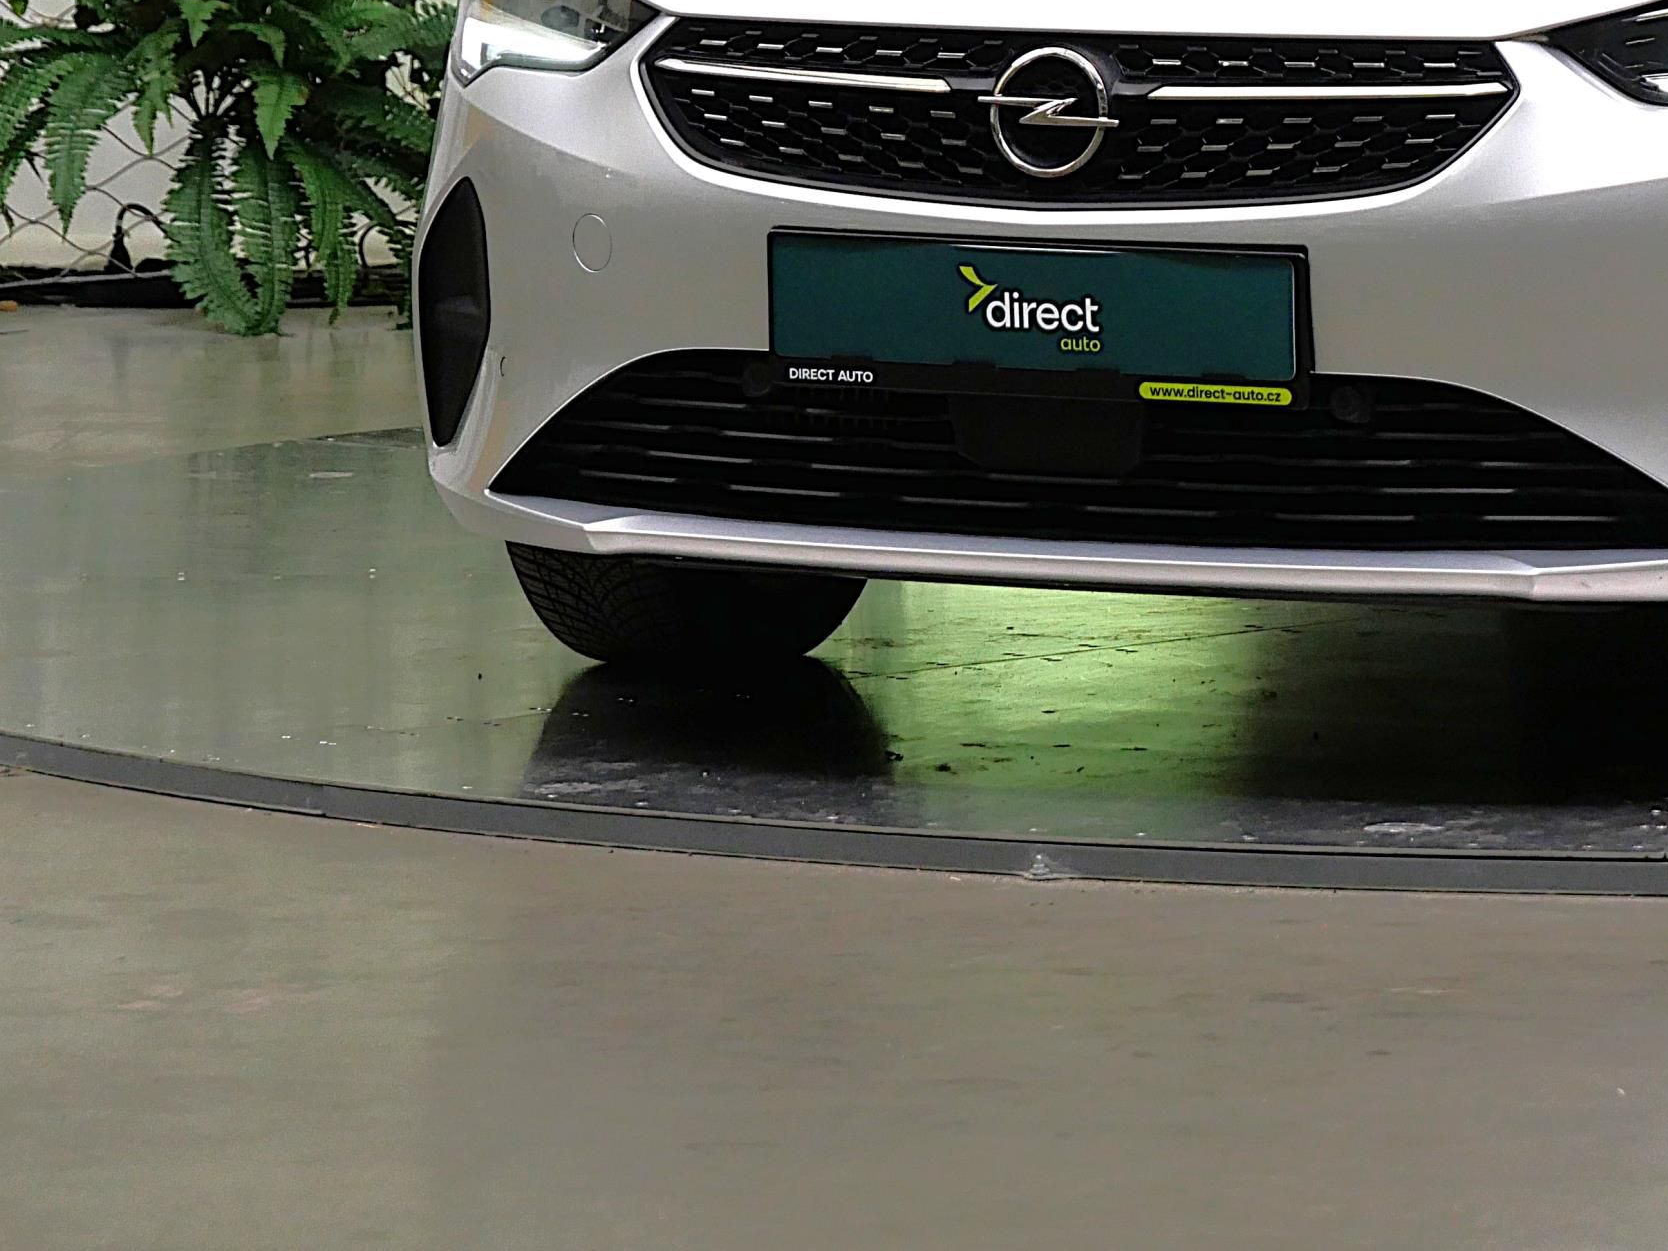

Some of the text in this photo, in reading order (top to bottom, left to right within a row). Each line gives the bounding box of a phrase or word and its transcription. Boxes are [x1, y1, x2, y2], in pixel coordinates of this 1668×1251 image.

[985, 291, 1100, 333] direct
[1060, 336, 1101, 352] auto
[789, 367, 874, 383] DIRECT AUTO
[1150, 386, 1282, 403] www.direct-auto.cz
